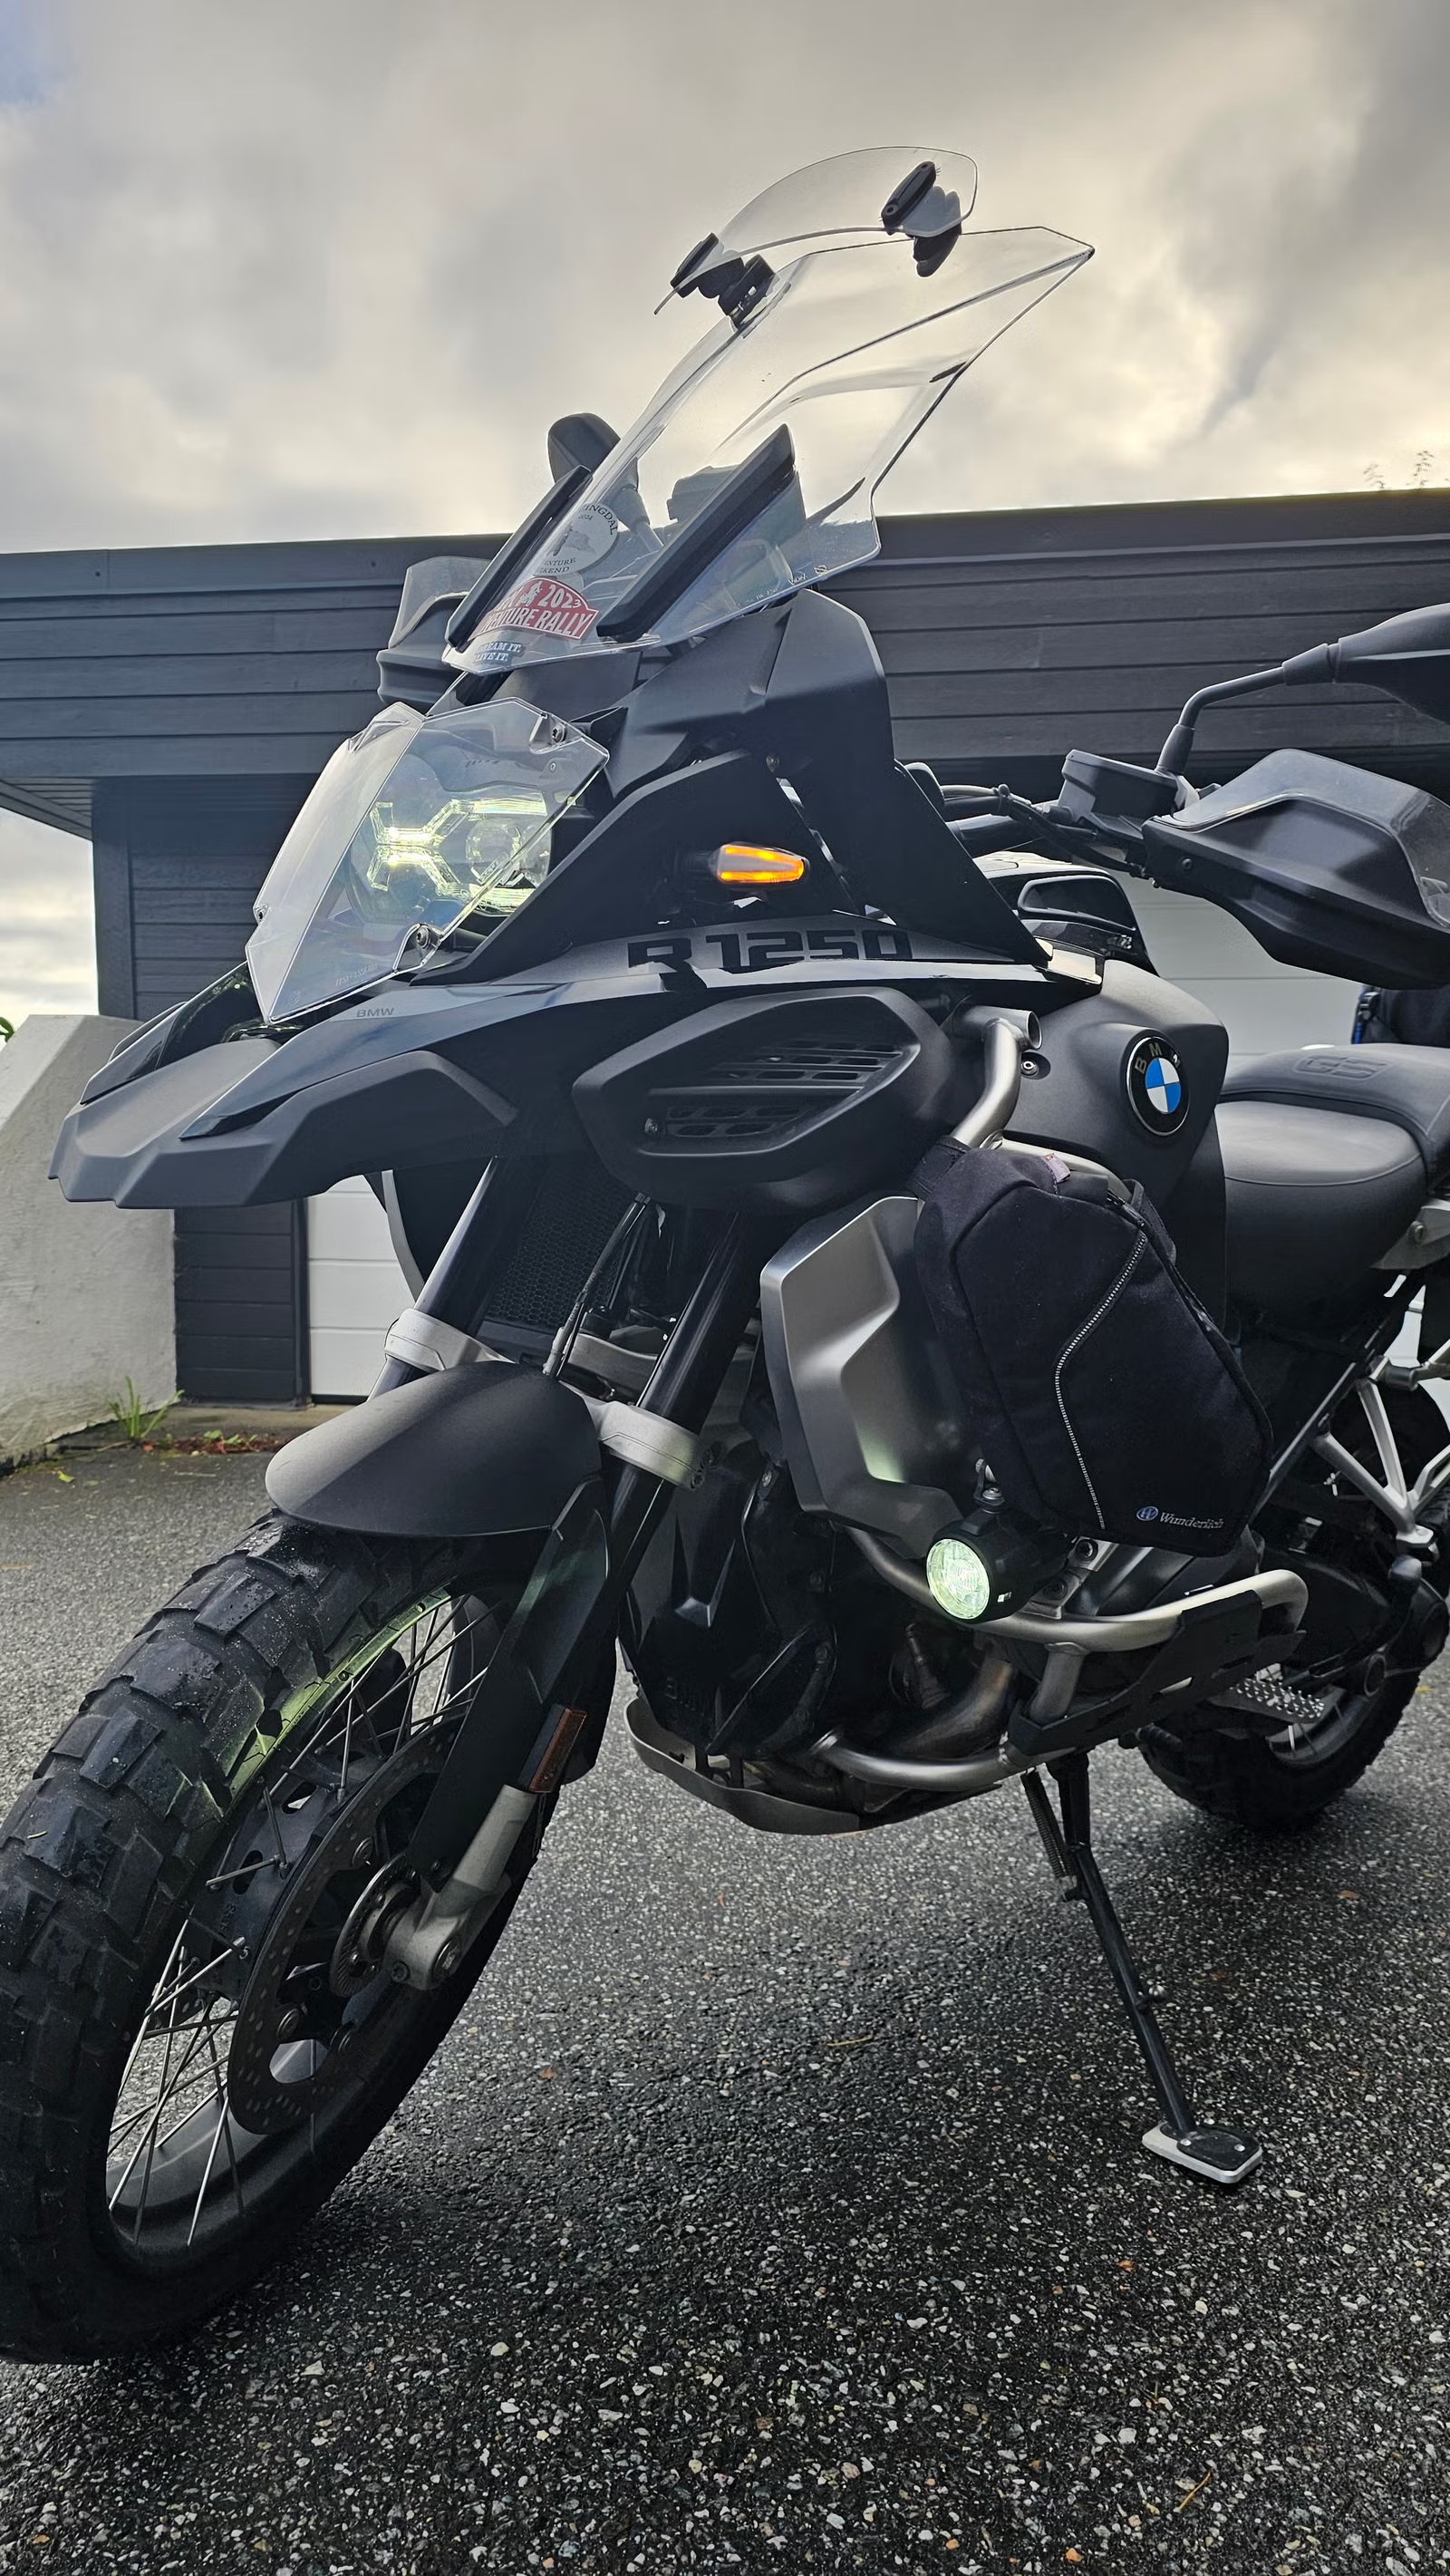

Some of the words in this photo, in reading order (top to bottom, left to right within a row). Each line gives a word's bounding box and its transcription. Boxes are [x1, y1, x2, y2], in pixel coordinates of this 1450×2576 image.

[537, 584, 582, 609] 2023
[535, 610, 594, 636] RALLY
[356, 1007, 395, 1018] BMW
[1296, 1054, 1388, 1080] GS
[1159, 1511, 1224, 1529] Wunderlich
